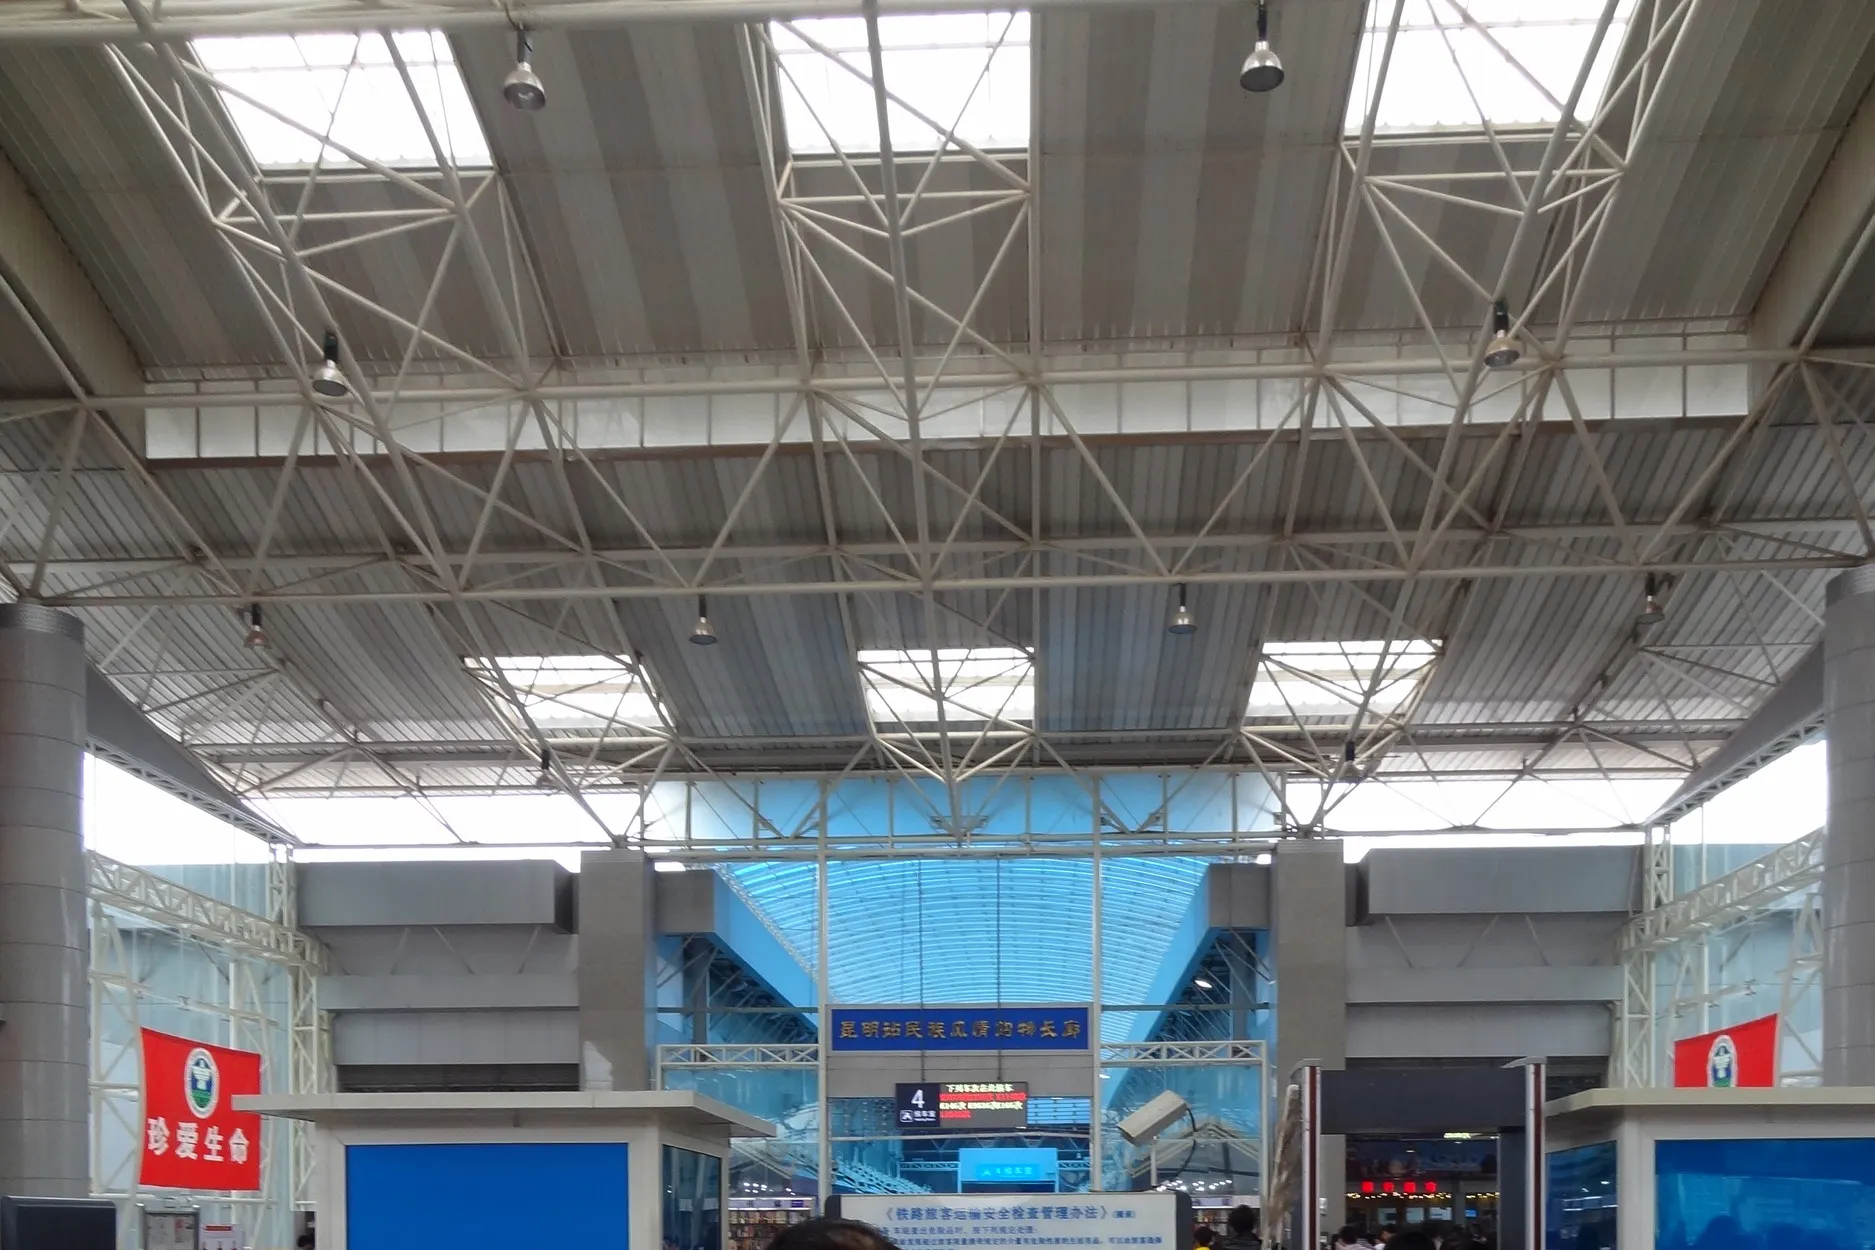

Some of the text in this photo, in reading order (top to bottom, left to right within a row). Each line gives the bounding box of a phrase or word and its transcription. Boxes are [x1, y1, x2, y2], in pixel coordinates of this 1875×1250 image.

[911, 1089, 925, 1108] 4
[147, 1116, 250, 1164] 珍爱生命
